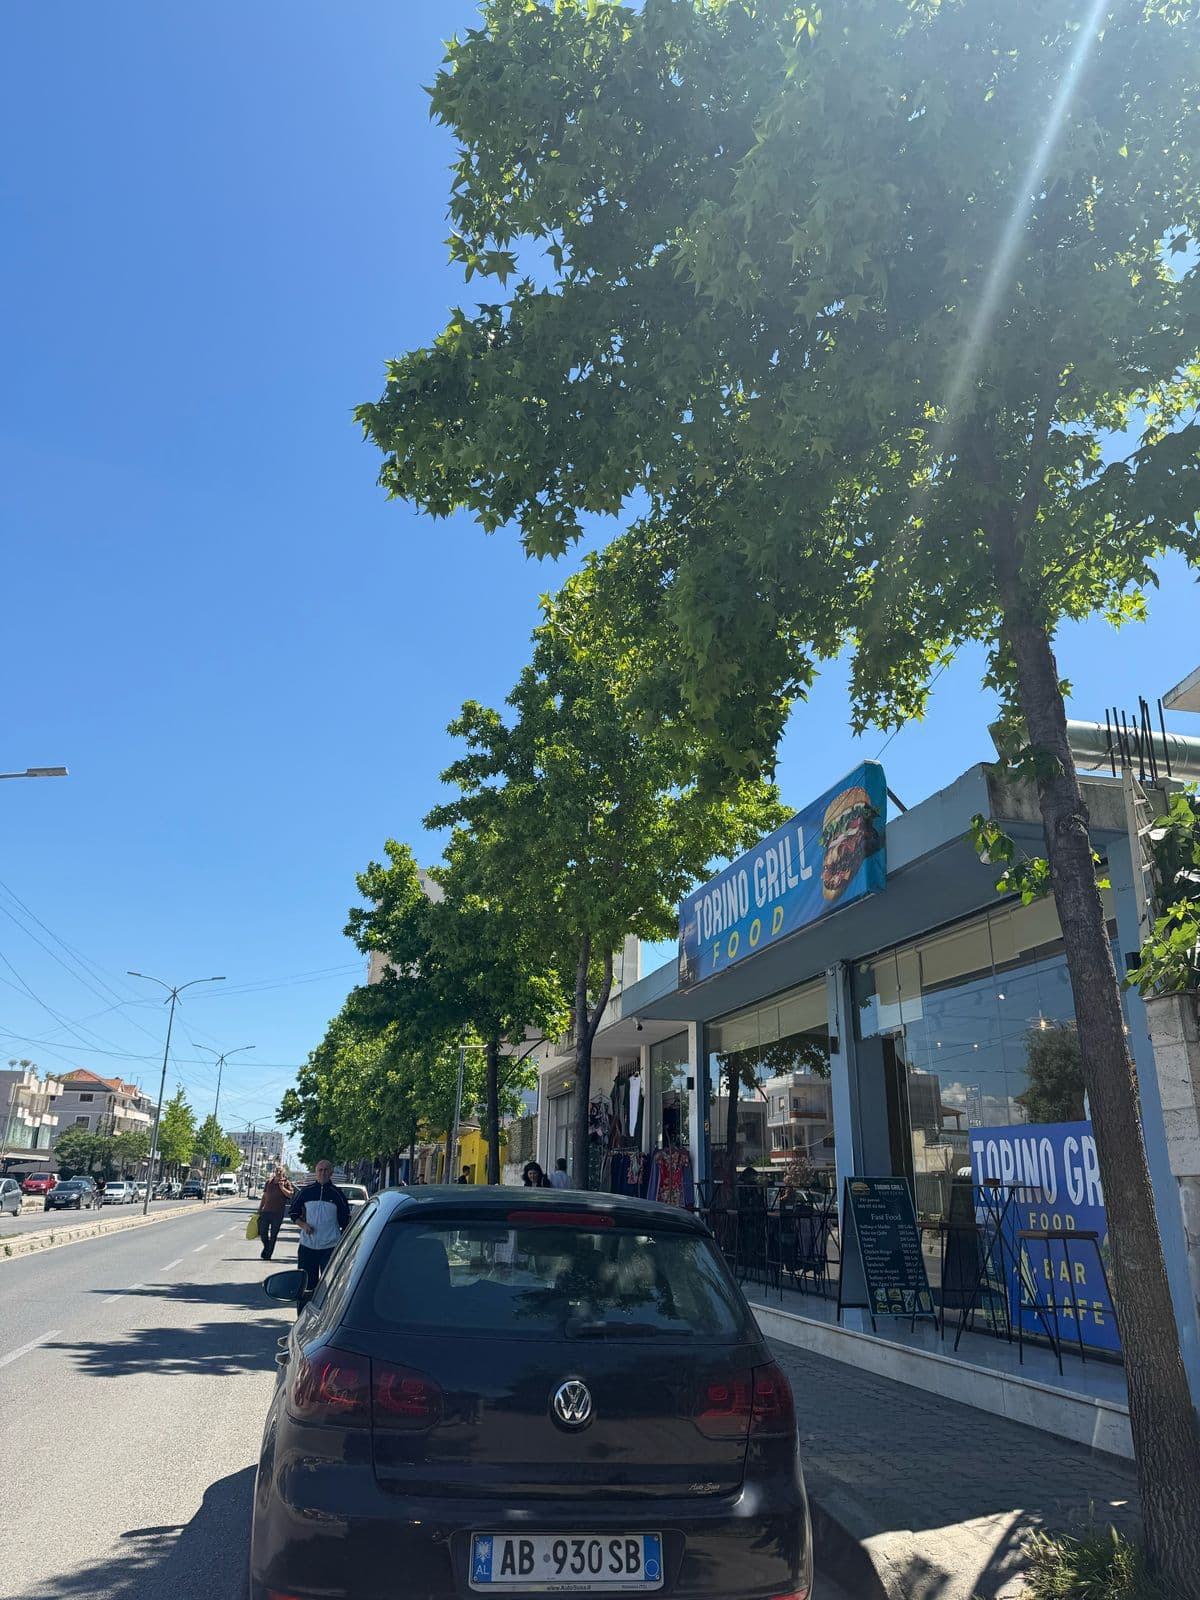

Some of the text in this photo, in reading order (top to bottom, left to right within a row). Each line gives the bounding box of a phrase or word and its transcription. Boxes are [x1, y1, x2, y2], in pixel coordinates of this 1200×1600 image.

[694, 826, 813, 946] TORINO GRILL
[712, 905, 784, 968] FOOD
[972, 1137, 1058, 1205] TORINO
[1029, 1212, 1075, 1231] FOOD
[1043, 1258, 1086, 1285] BAR
[475, 1564, 489, 1575] AL
[501, 1539, 642, 1575] AB 930 SB
